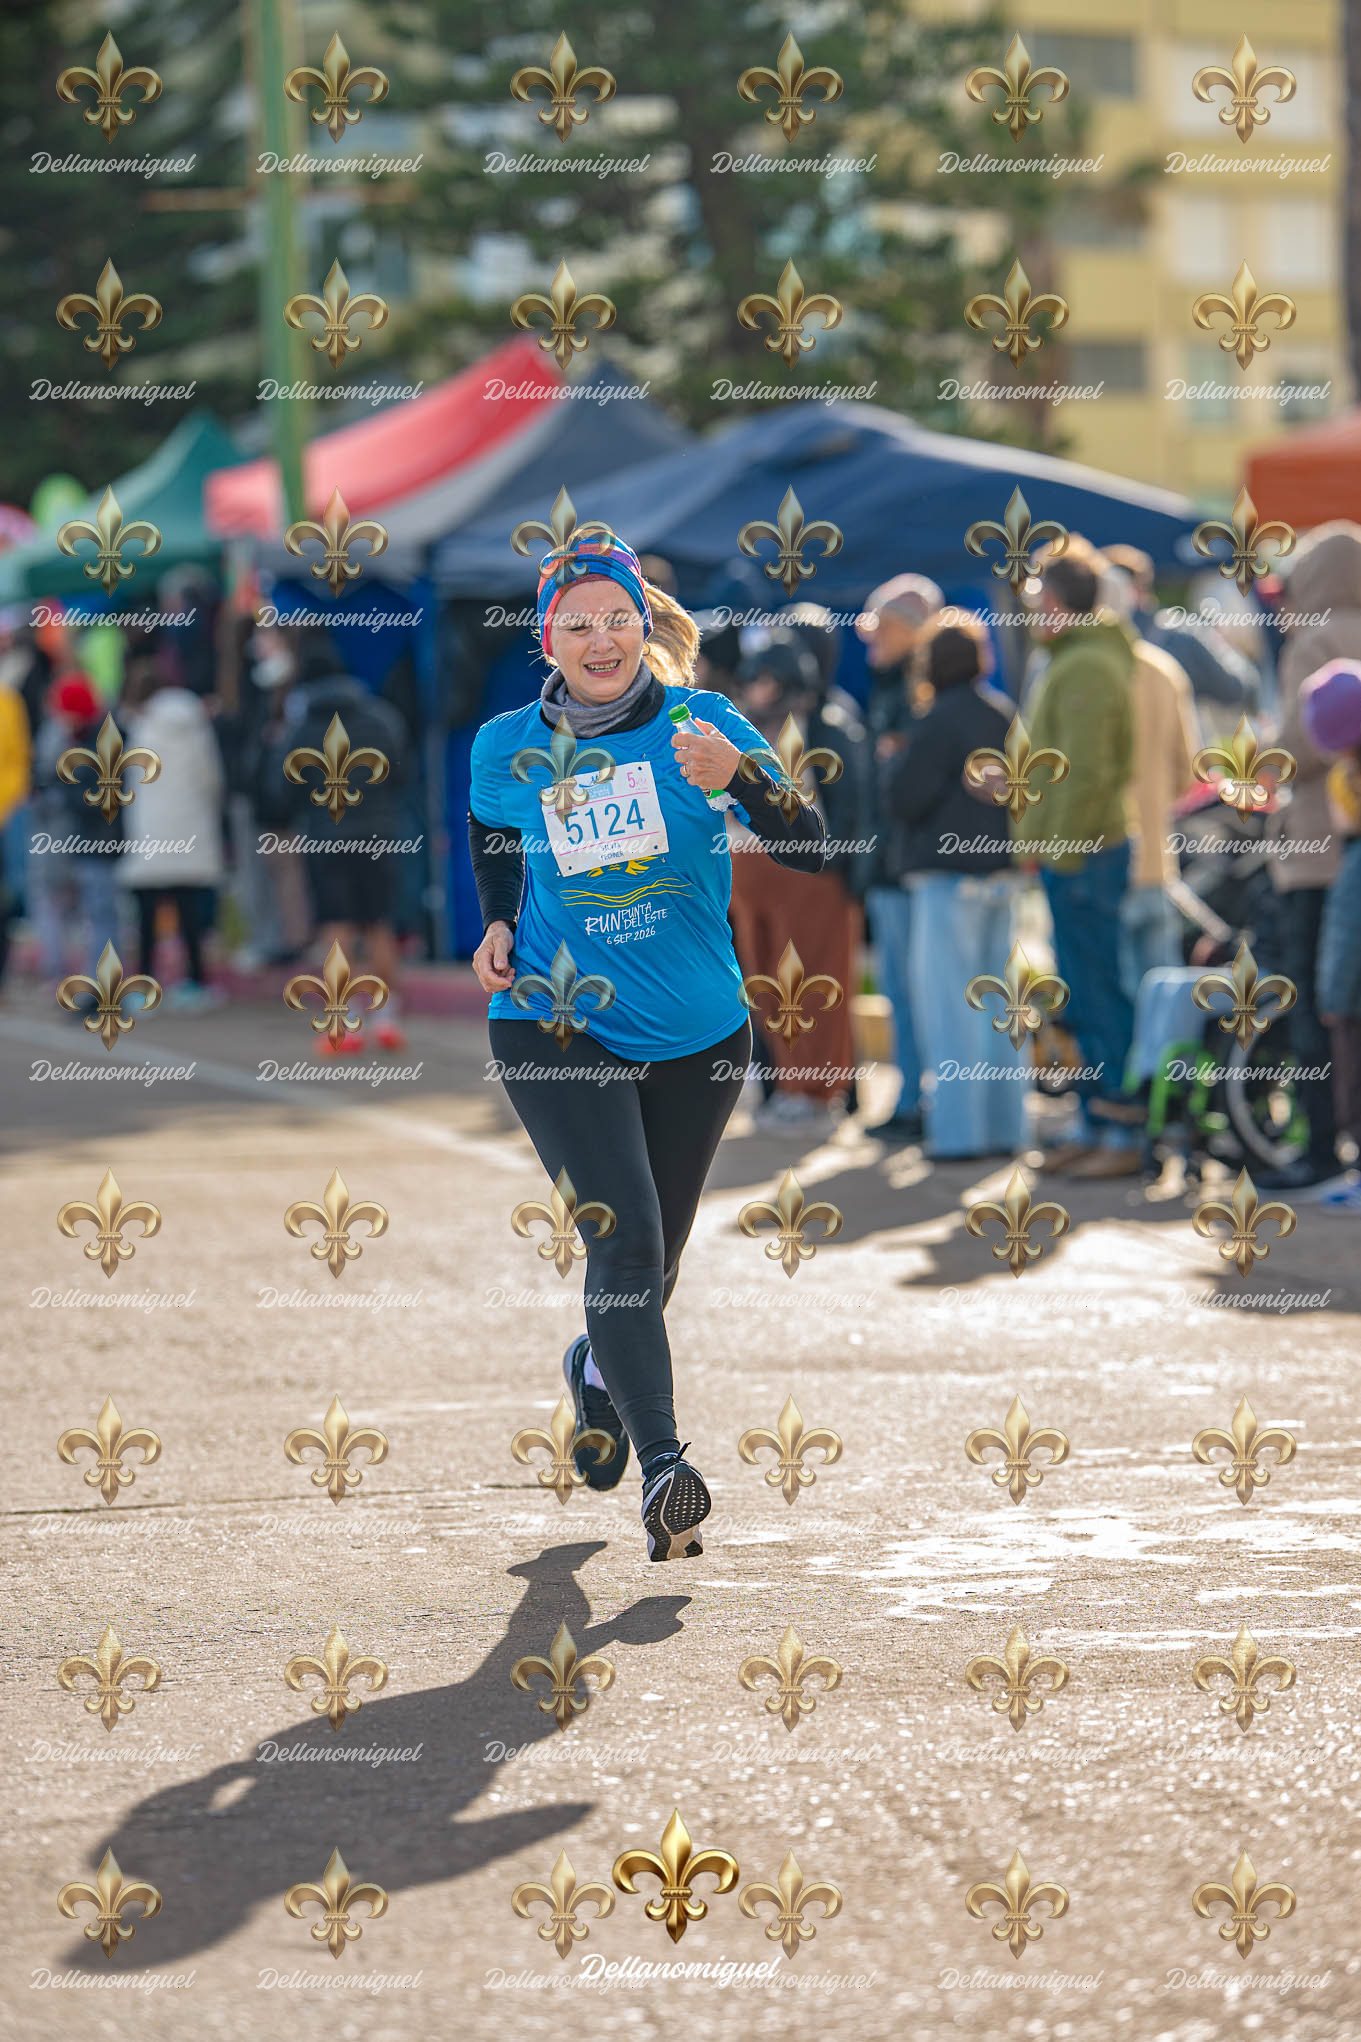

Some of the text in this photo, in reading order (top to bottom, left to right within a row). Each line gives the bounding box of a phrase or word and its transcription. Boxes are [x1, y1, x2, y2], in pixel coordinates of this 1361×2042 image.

[564, 799, 645, 845] 5124
[621, 901, 652, 920] PUNTA
[624, 908, 668, 930] DEL ESTE
[584, 909, 621, 936] RUN
[606, 925, 656, 945] 6 SEP 2026
